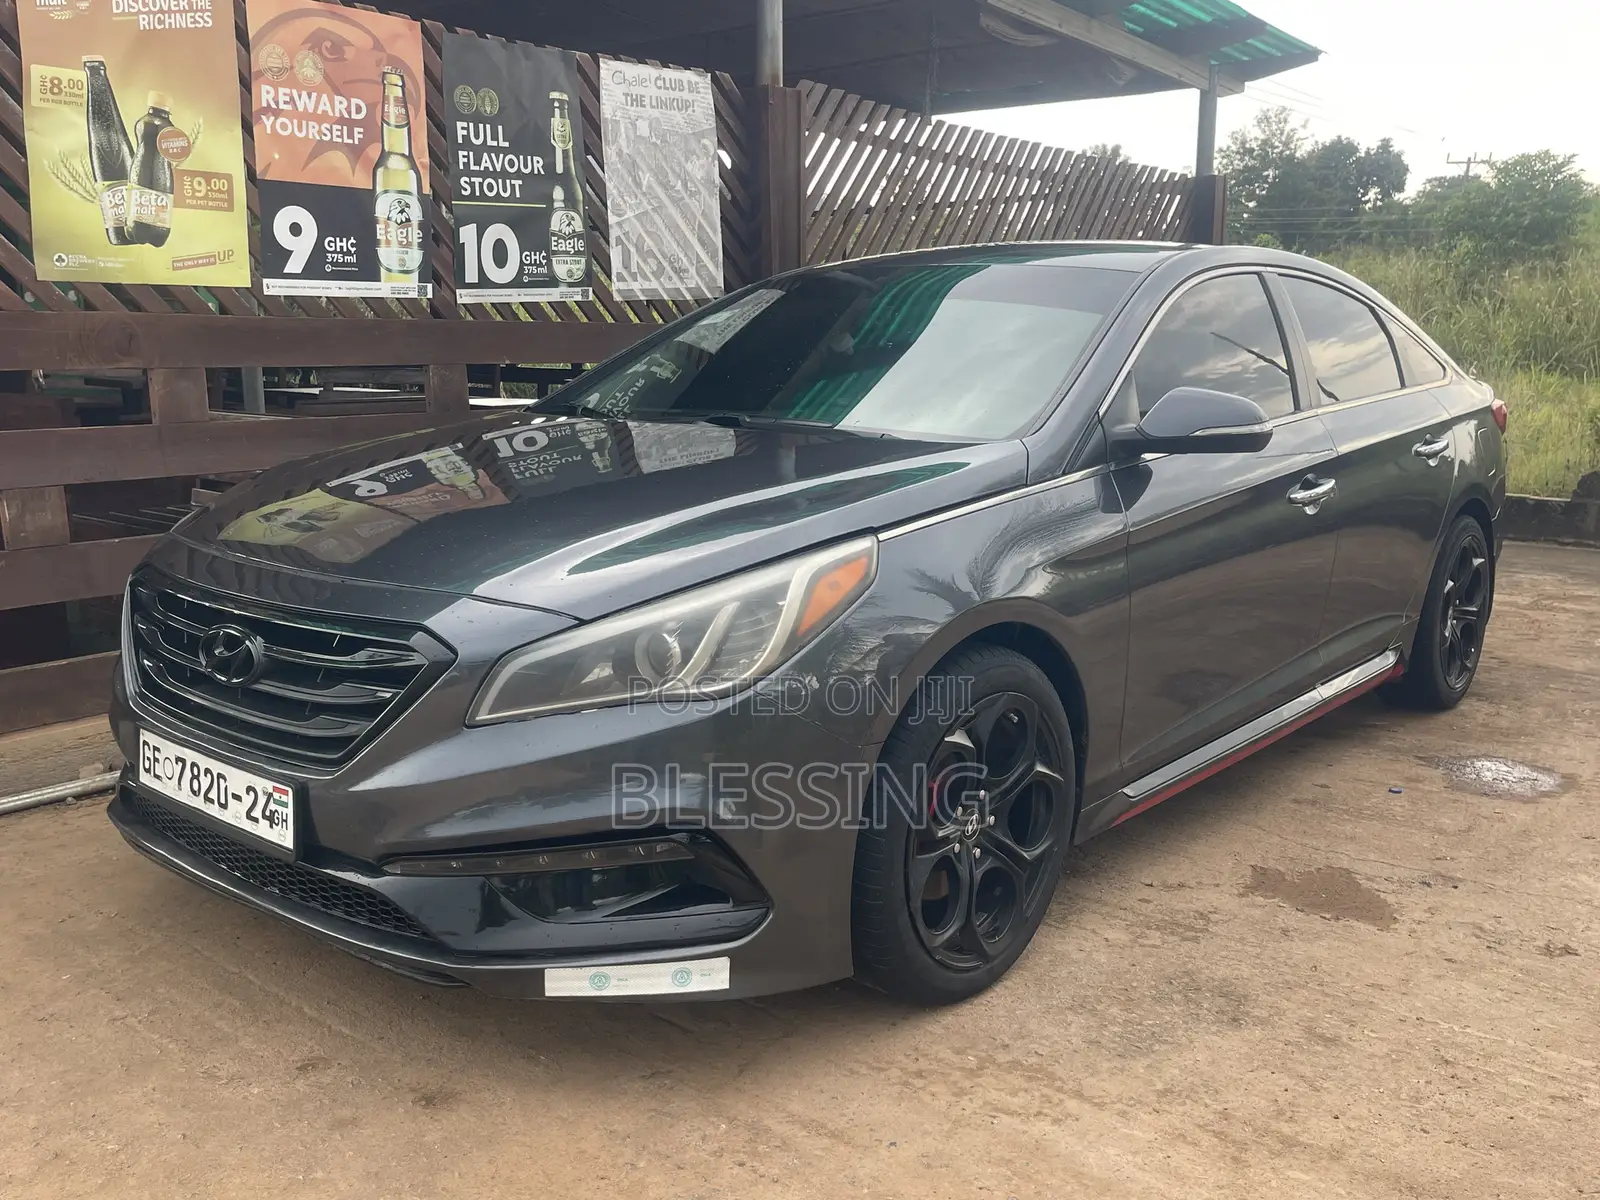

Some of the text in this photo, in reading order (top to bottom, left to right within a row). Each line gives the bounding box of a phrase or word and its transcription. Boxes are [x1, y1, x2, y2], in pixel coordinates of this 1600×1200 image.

[112, 0, 213, 13] DISCOVER THE
[139, 12, 213, 31] RICHNESS
[49, 76, 84, 97] 8.00
[612, 70, 701, 94] Chale! CLUB BE
[260, 84, 367, 120] REWARD
[622, 92, 696, 113] THE LINKUP!
[260, 114, 364, 145] YOURSELF
[456, 121, 510, 147] FULL
[161, 139, 188, 149] VITAMINS
[458, 150, 545, 175] FLAVOUR
[193, 177, 228, 197] 9.00
[460, 176, 523, 198] STOUT
[273, 205, 318, 274] 9
[376, 223, 423, 244] Eagle
[324, 236, 357, 253] GH¢
[459, 222, 521, 284] 10
[551, 236, 585, 254] Eagle
[217, 249, 235, 262] UP
[522, 250, 547, 265] GH¢
[142, 739, 163, 782] GE
[273, 809, 288, 831] GH
